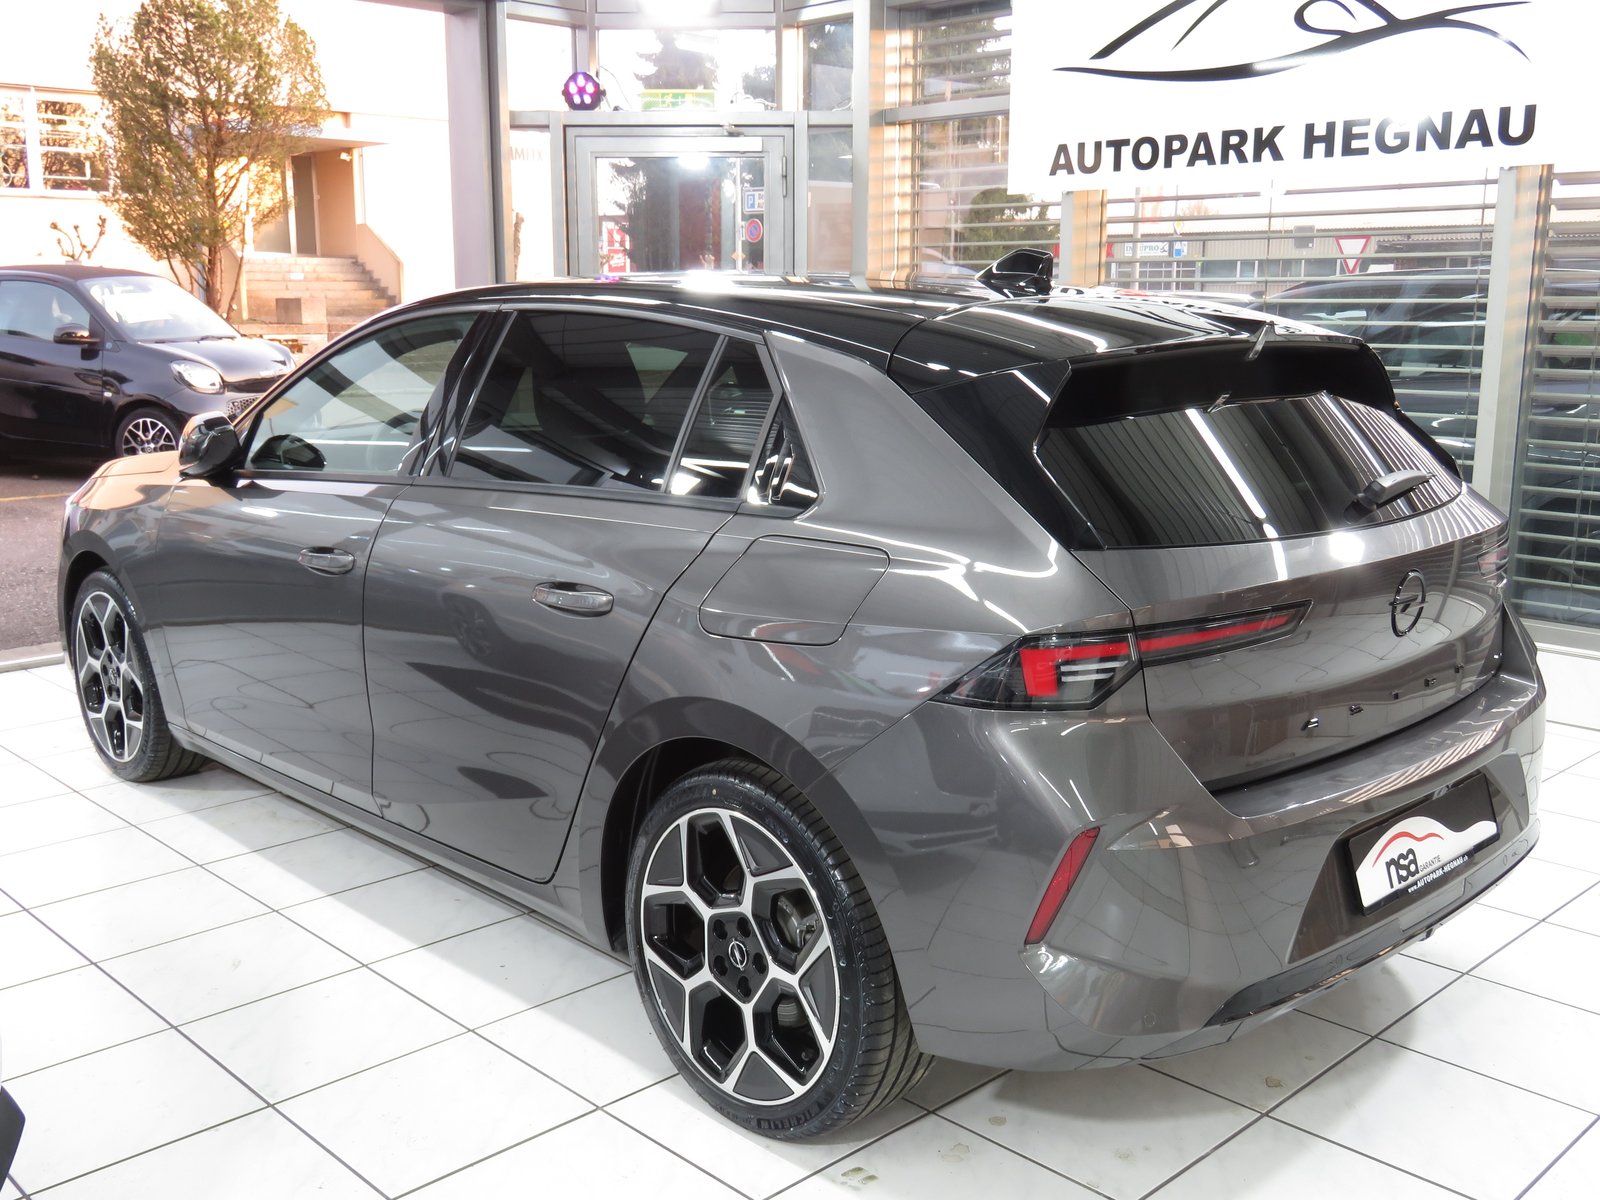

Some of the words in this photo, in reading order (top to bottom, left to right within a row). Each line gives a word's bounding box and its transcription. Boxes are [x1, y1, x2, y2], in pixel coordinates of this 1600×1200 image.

[1049, 125, 1285, 177] AUTOPARK
[1303, 104, 1537, 160] HEGNAU
[1385, 848, 1419, 889] nsa
[1419, 855, 1441, 872] GARANTIE
